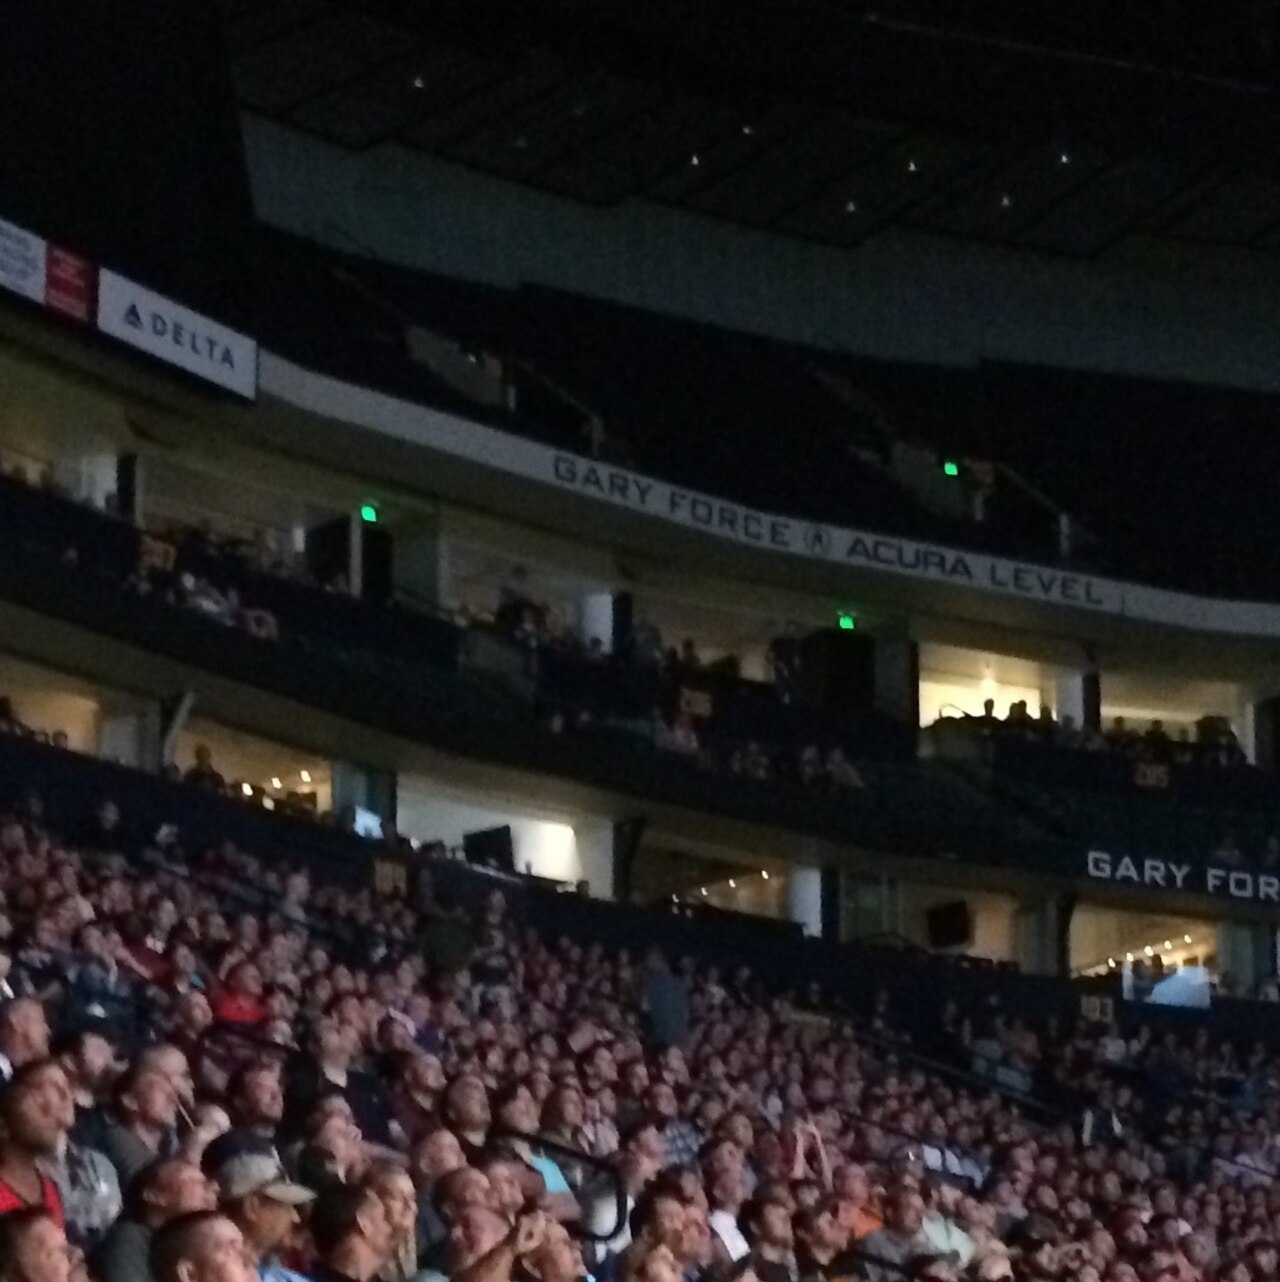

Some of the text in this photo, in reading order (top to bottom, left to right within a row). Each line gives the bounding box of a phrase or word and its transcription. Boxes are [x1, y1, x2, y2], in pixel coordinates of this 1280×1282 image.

[151, 312, 236, 370] DELTA
[554, 455, 1103, 604] GARY FORCE ACURA LEVEL
[1087, 850, 1191, 889] GARY
